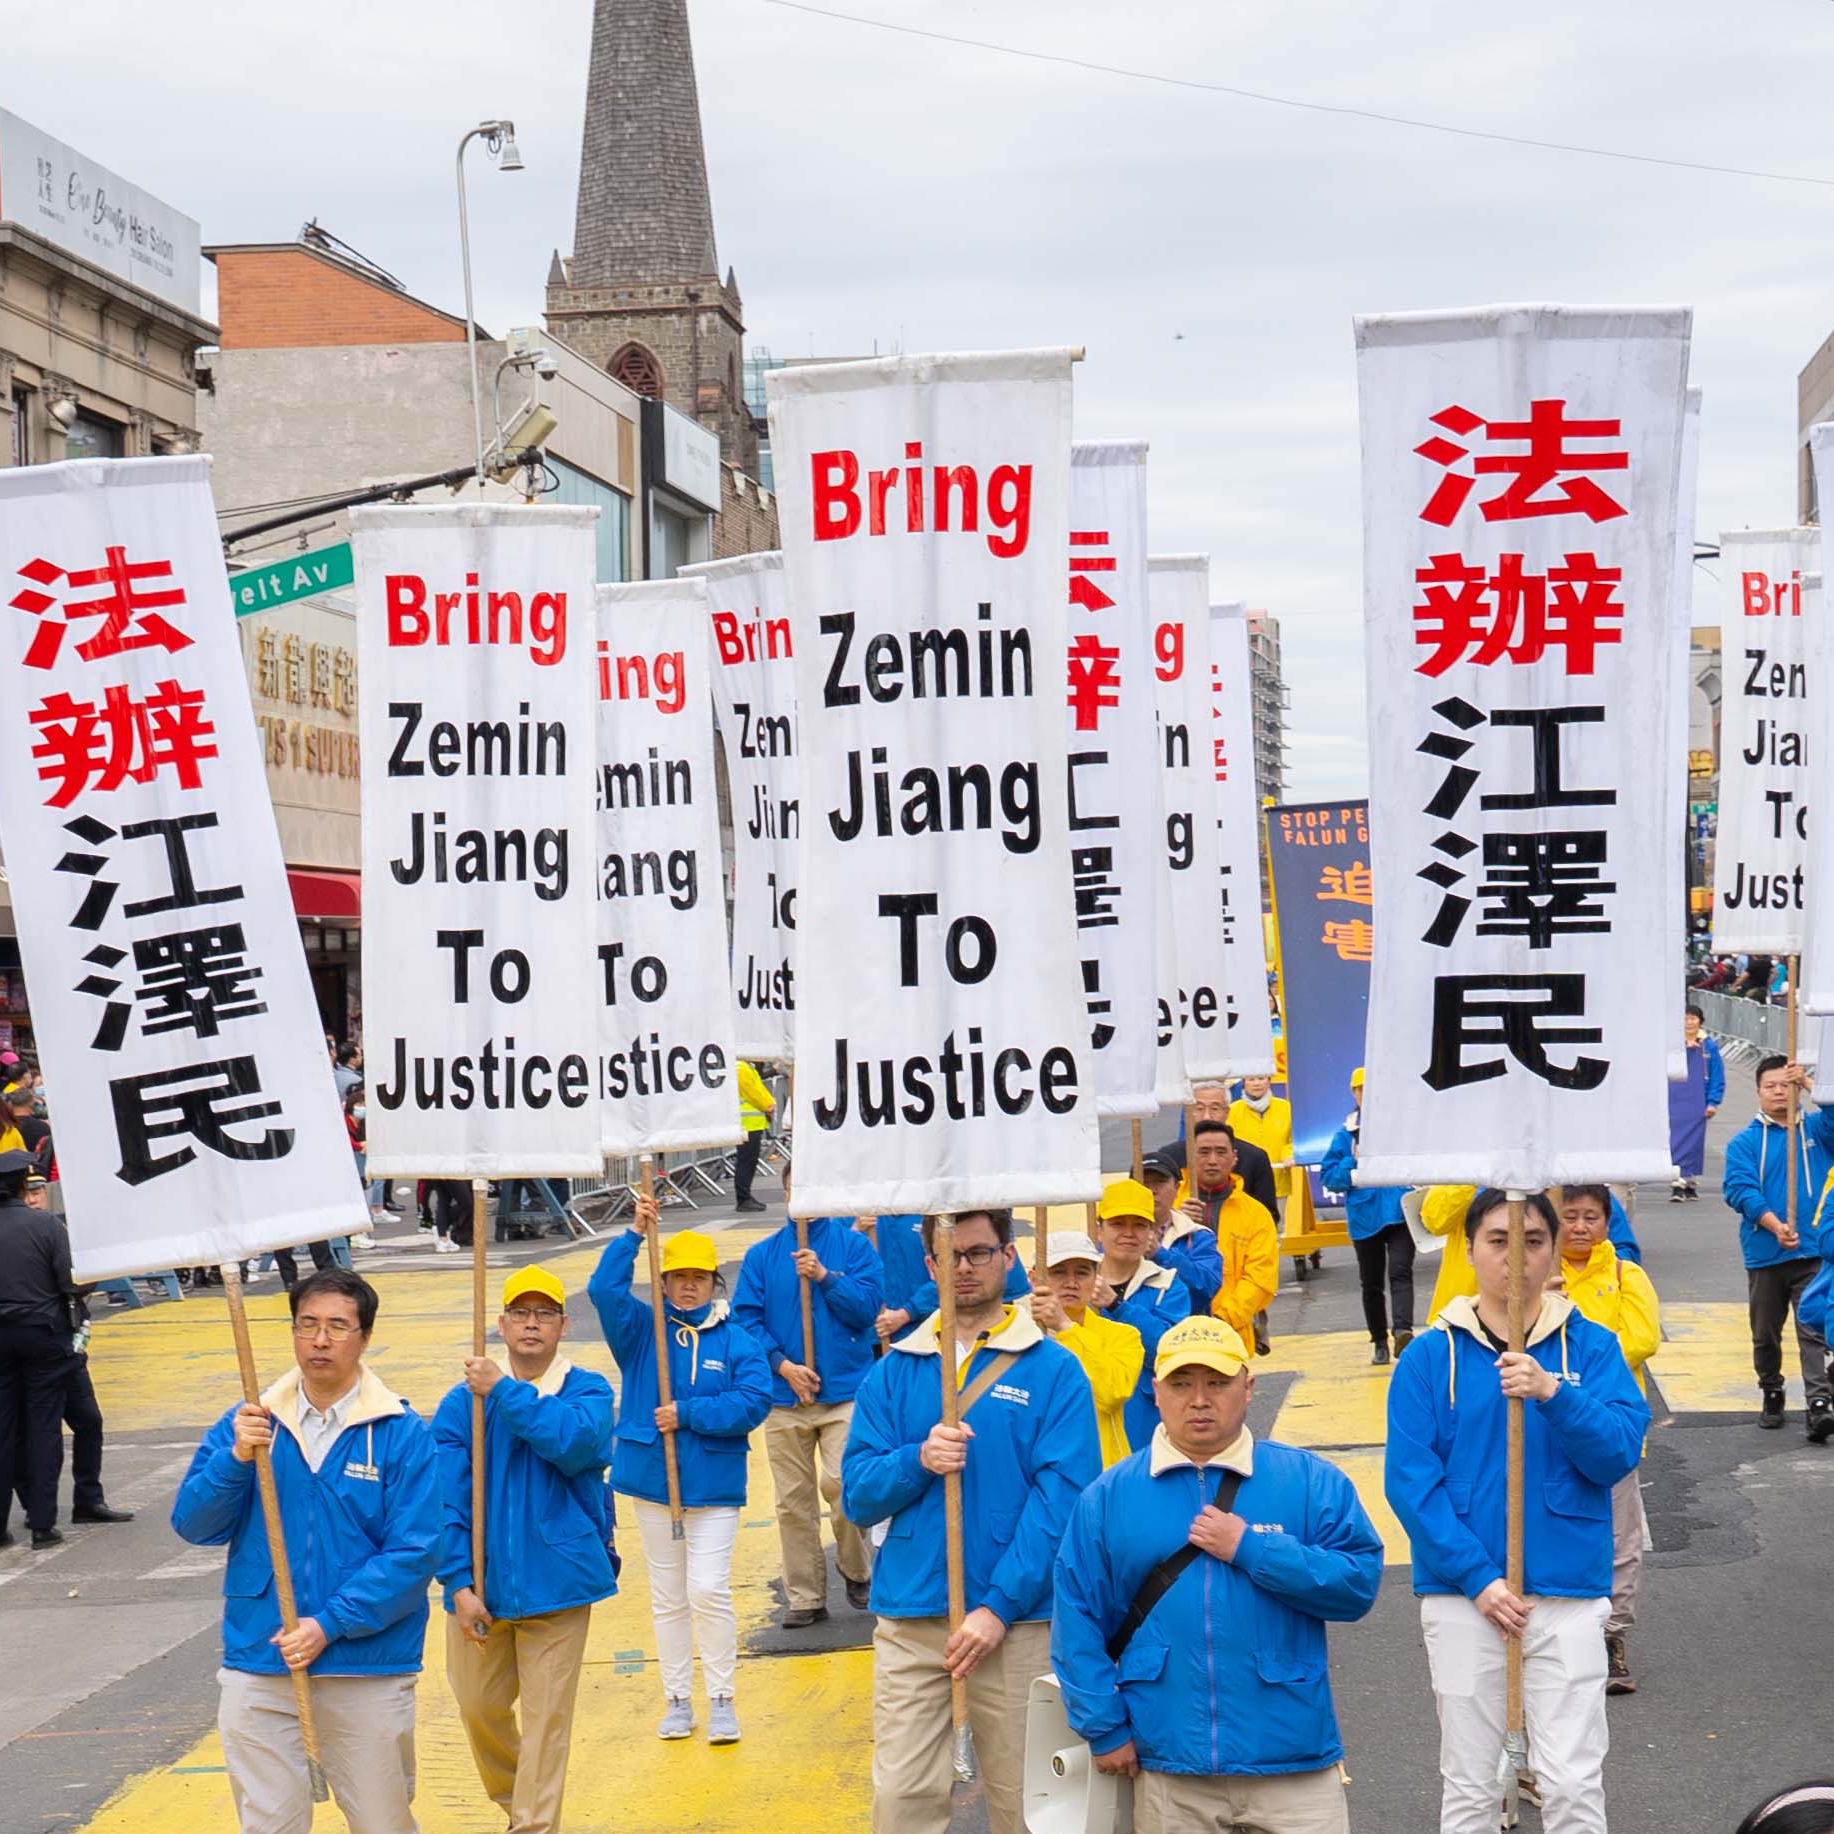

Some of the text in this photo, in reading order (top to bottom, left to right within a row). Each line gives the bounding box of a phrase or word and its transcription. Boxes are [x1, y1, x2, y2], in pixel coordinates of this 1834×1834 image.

[812, 442, 1032, 558] Bring
[292, 562, 329, 591] Av
[386, 573, 567, 665] Bring
[712, 607, 794, 666] Brin
[820, 603, 1032, 707] Zemin
[598, 640, 686, 714] ing
[388, 703, 565, 776] Zemin
[1414, 400, 1628, 1091] 法辦江澤民
[829, 748, 1040, 853] Jiang
[1280, 808, 1364, 828] STOP PE
[1283, 827, 1369, 846] FALUN G
[9, 547, 296, 1185] 法辦江澤民
[390, 812, 568, 900] Jiang
[1723, 862, 1804, 910] Just
[437, 930, 530, 1003] To
[598, 942, 668, 1005] To
[879, 893, 996, 986] To
[738, 955, 795, 1010] Just
[377, 1037, 588, 1110] Justice
[600, 1032, 727, 1100] stice
[814, 1028, 1077, 1130] Justice
